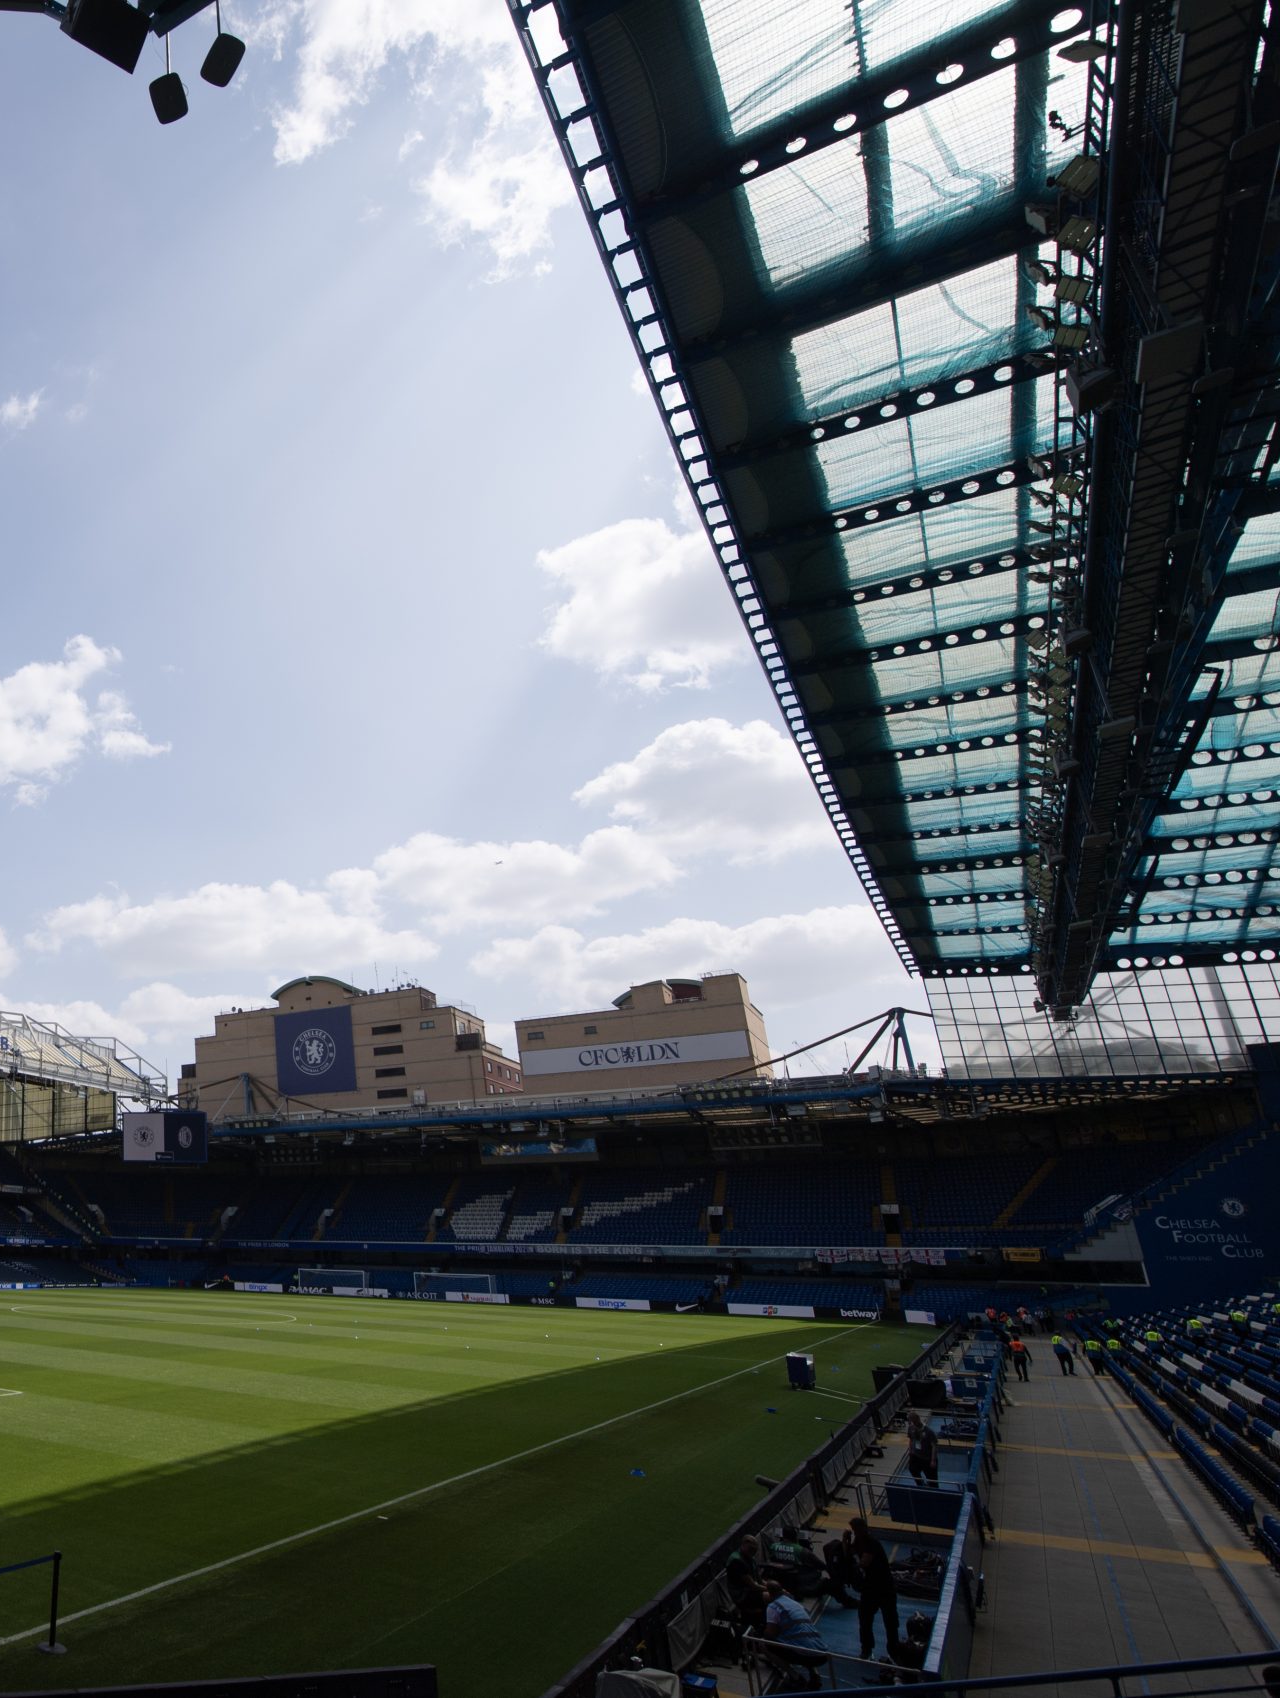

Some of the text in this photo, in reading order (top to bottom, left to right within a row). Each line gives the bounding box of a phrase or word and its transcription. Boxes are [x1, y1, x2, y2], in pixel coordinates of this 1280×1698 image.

[299, 1031, 326, 1042] CHELSEA
[578, 1042, 681, 1066] CFC LDN
[1154, 1216, 1222, 1229] CHELSEA
[1171, 1230, 1252, 1243] FOOTBALL
[536, 1246, 567, 1254] BORN
[571, 1246, 581, 1254] IS
[588, 1246, 609, 1255] THE
[613, 1247, 642, 1255] KING
[1221, 1244, 1265, 1258] CLUB
[406, 1291, 438, 1299] ASCOTT
[538, 1297, 555, 1305] MSC
[840, 1308, 877, 1320] betway
